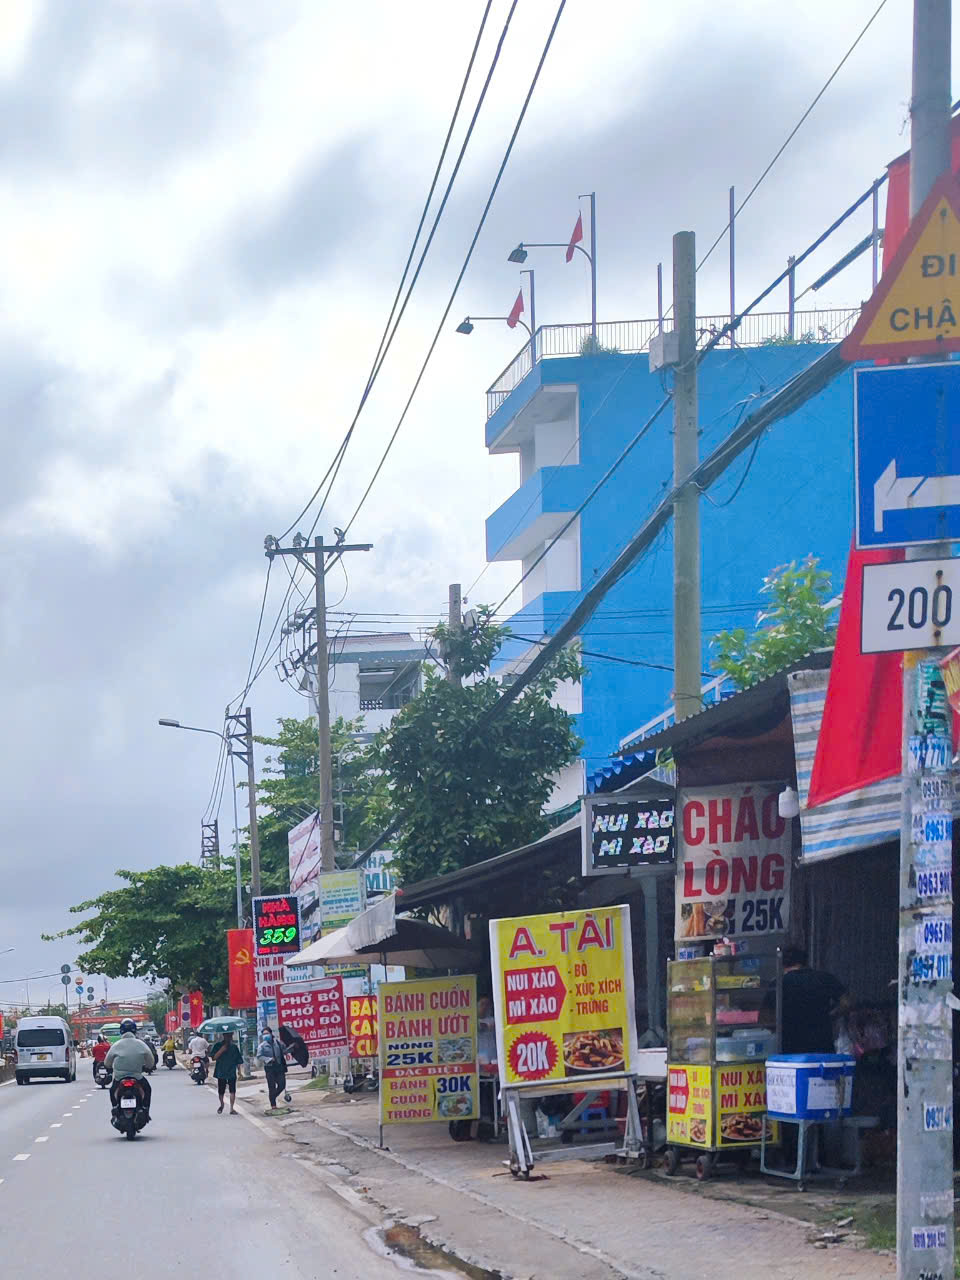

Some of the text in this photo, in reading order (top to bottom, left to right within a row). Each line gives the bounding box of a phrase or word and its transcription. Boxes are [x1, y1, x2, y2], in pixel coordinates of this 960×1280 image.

[921, 253, 956, 278] ĐI
[889, 297, 958, 334] CHẬ
[887, 584, 952, 632] 200
[592, 813, 629, 833] NUI
[682, 785, 786, 847] CHÁO
[682, 849, 785, 898] LÒNG
[262, 897, 291, 913] NHÀ
[741, 897, 785, 933] 25K
[259, 926, 297, 945] 359
[548, 911, 614, 953] TÀI
[506, 967, 556, 992] NUI XÀO
[575, 976, 622, 997] XÚC XÍCH
[280, 992, 313, 1006] PHỞ
[281, 1001, 340, 1018] PHỞ GÀ
[384, 983, 470, 1013] BÁNH CUỐN
[509, 992, 557, 1018] MÌ XÀO
[282, 1013, 341, 1029] BÚN BÒ
[385, 1011, 471, 1039] BÁNH ƯỚT
[356, 1039, 378, 1056] CU
[386, 1051, 434, 1066] 25K
[516, 1040, 550, 1073] 20K
[389, 1079, 428, 1090] BÁNH
[436, 1075, 472, 1094] 30K
[720, 1065, 764, 1087] NUI XÀ
